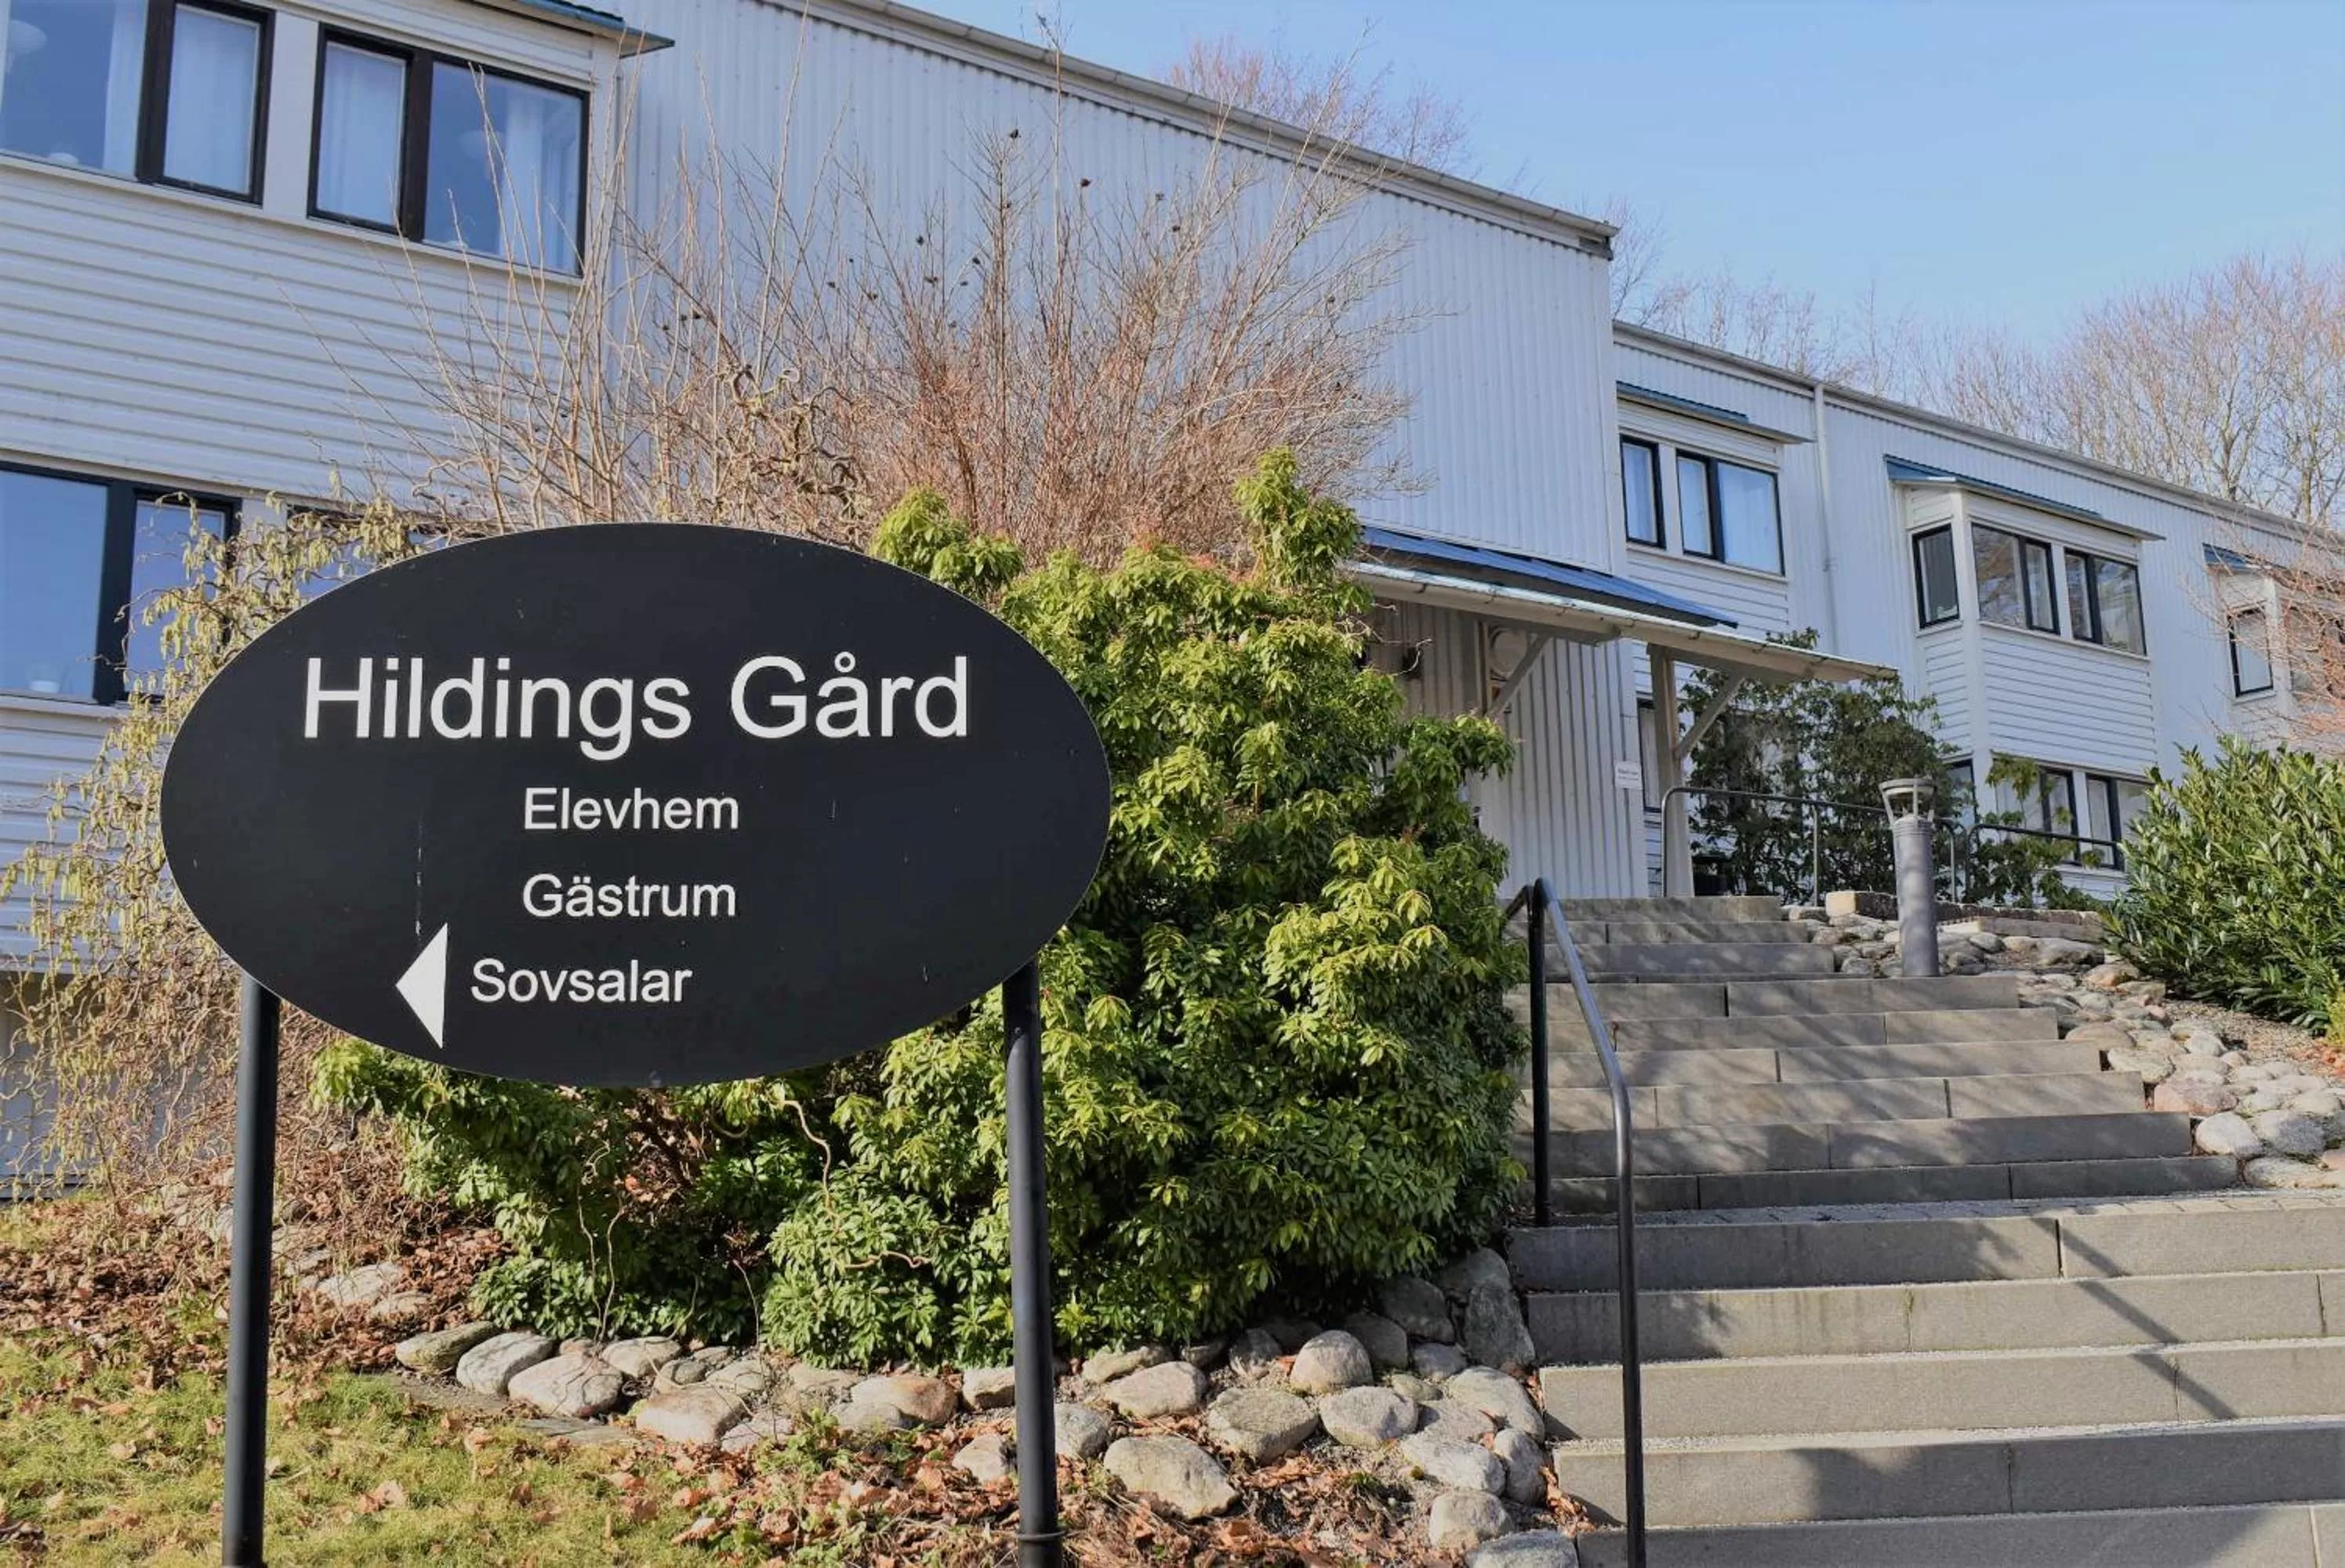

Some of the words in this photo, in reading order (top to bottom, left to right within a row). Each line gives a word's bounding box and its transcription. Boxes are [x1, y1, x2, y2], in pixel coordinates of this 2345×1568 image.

[304, 657, 692, 760] Hildings
[731, 651, 967, 739] Gård
[525, 787, 739, 829] Elevhem
[523, 873, 735, 917] Gästrum
[471, 958, 693, 1003] Sovsalar
